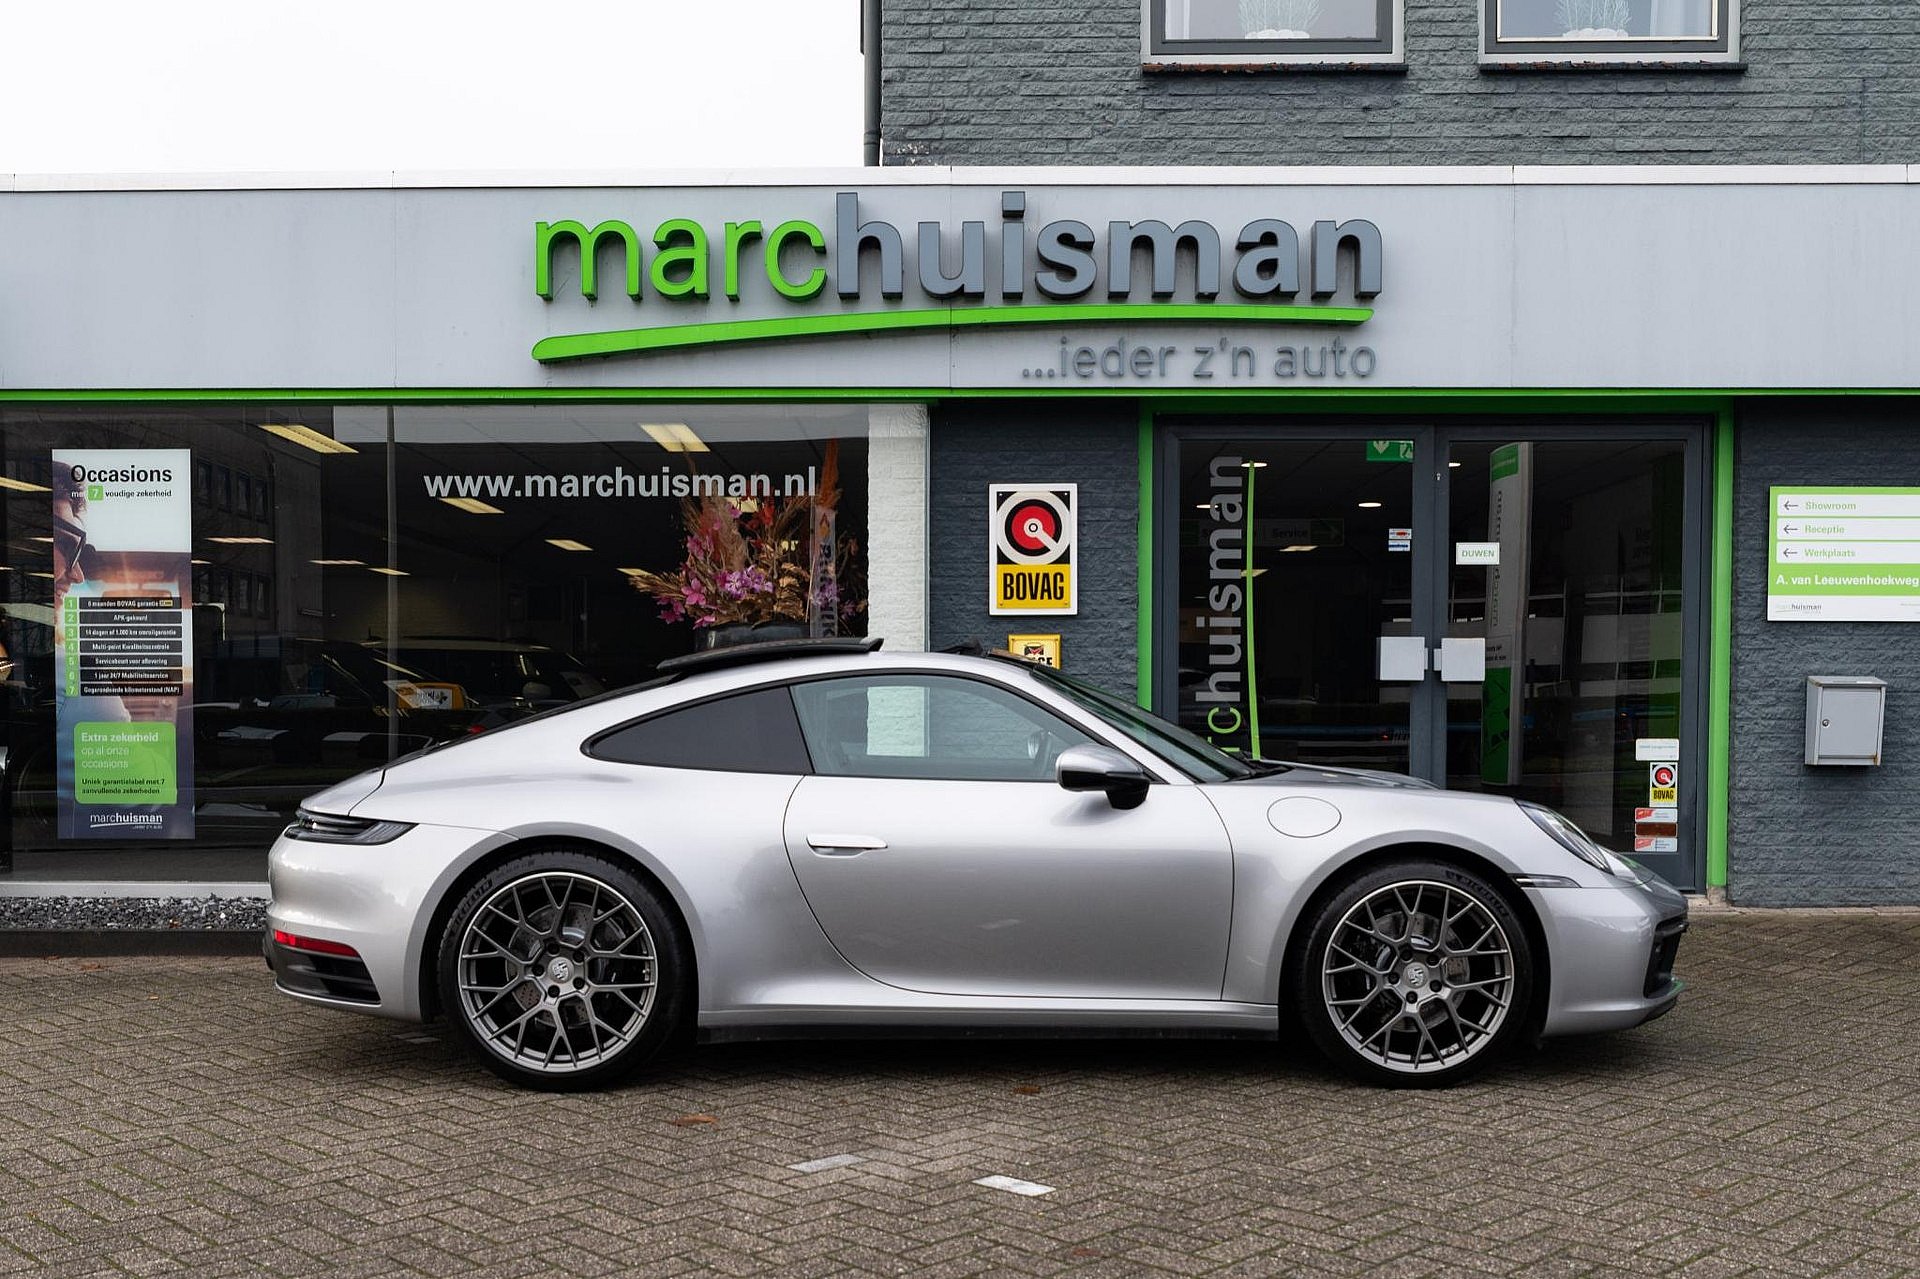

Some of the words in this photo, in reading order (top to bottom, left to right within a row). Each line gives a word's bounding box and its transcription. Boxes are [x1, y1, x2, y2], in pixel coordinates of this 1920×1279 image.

[533, 190, 1384, 302] marchuisman
[1021, 337, 1177, 379] ...ieder
[1195, 337, 1254, 379] z'n
[1270, 340, 1378, 379] auto
[70, 464, 173, 482] Occasions
[423, 466, 816, 498] www.marchuisman.nl
[105, 489, 135, 499] voudige
[136, 489, 172, 498] zekerheid
[1805, 501, 1857, 510] Showroom
[1804, 525, 1845, 535] Receptie
[1461, 549, 1495, 558] DUWEN
[1804, 548, 1856, 559] Werkplaats
[1002, 571, 1065, 601] BOVAG
[1776, 574, 1788, 585] A.
[1791, 576, 1811, 585] van
[1814, 574, 1920, 587] Leeuwenhoekweg
[137, 600, 158, 608] garantie
[1195, 456, 1243, 752] rchuisman
[163, 686, 180, 694] (NAP)
[81, 732, 107, 742] Extra
[110, 732, 159, 742] zekerheid
[81, 747, 94, 756] op
[96, 745, 104, 755] al
[106, 747, 130, 755] onze
[81, 760, 129, 769] occasions
[102, 778, 145, 787] garantielabel
[1653, 789, 1674, 800] BOVAG
[90, 812, 163, 823] marchuisman
